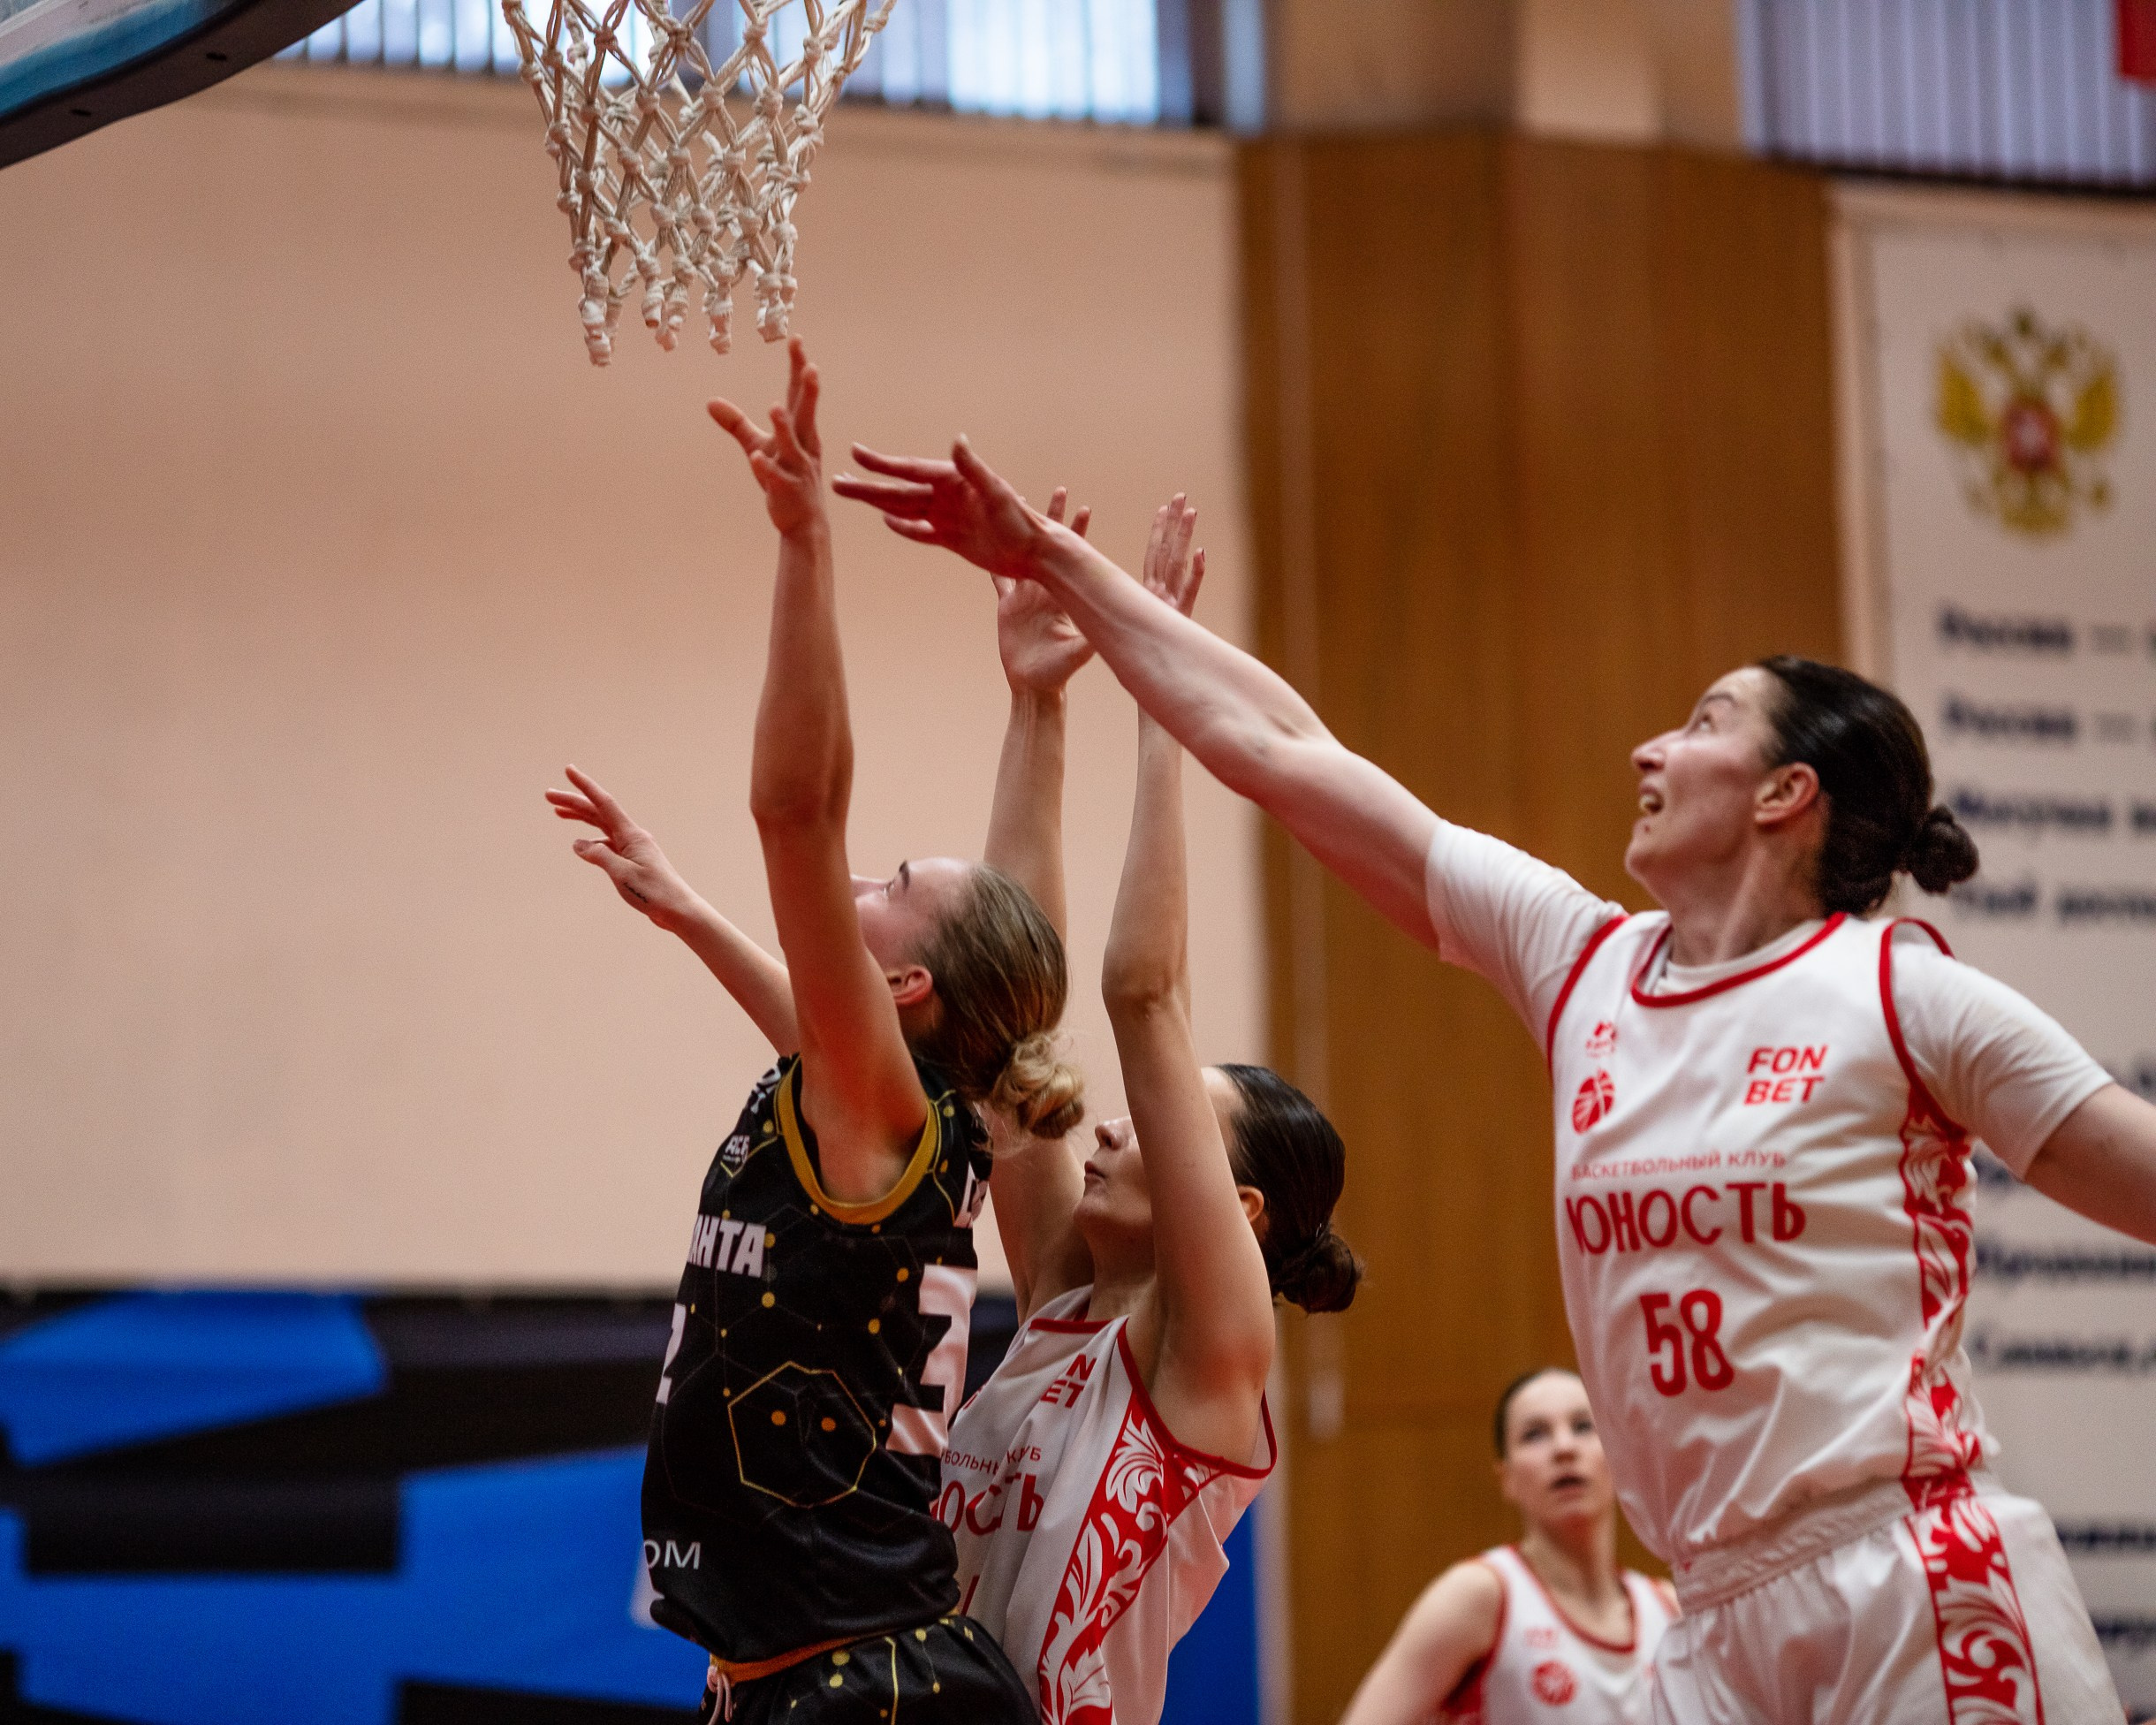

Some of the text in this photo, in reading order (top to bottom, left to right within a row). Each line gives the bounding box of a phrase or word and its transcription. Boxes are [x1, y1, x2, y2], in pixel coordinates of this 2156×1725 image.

[1748, 1045, 1827, 1074] FON
[1743, 1077, 1825, 1106] BET
[1566, 1182, 1806, 1256] ЮНОСТЬ
[1641, 1288, 1735, 1397] 58
[1040, 1379, 1085, 1409] ET
